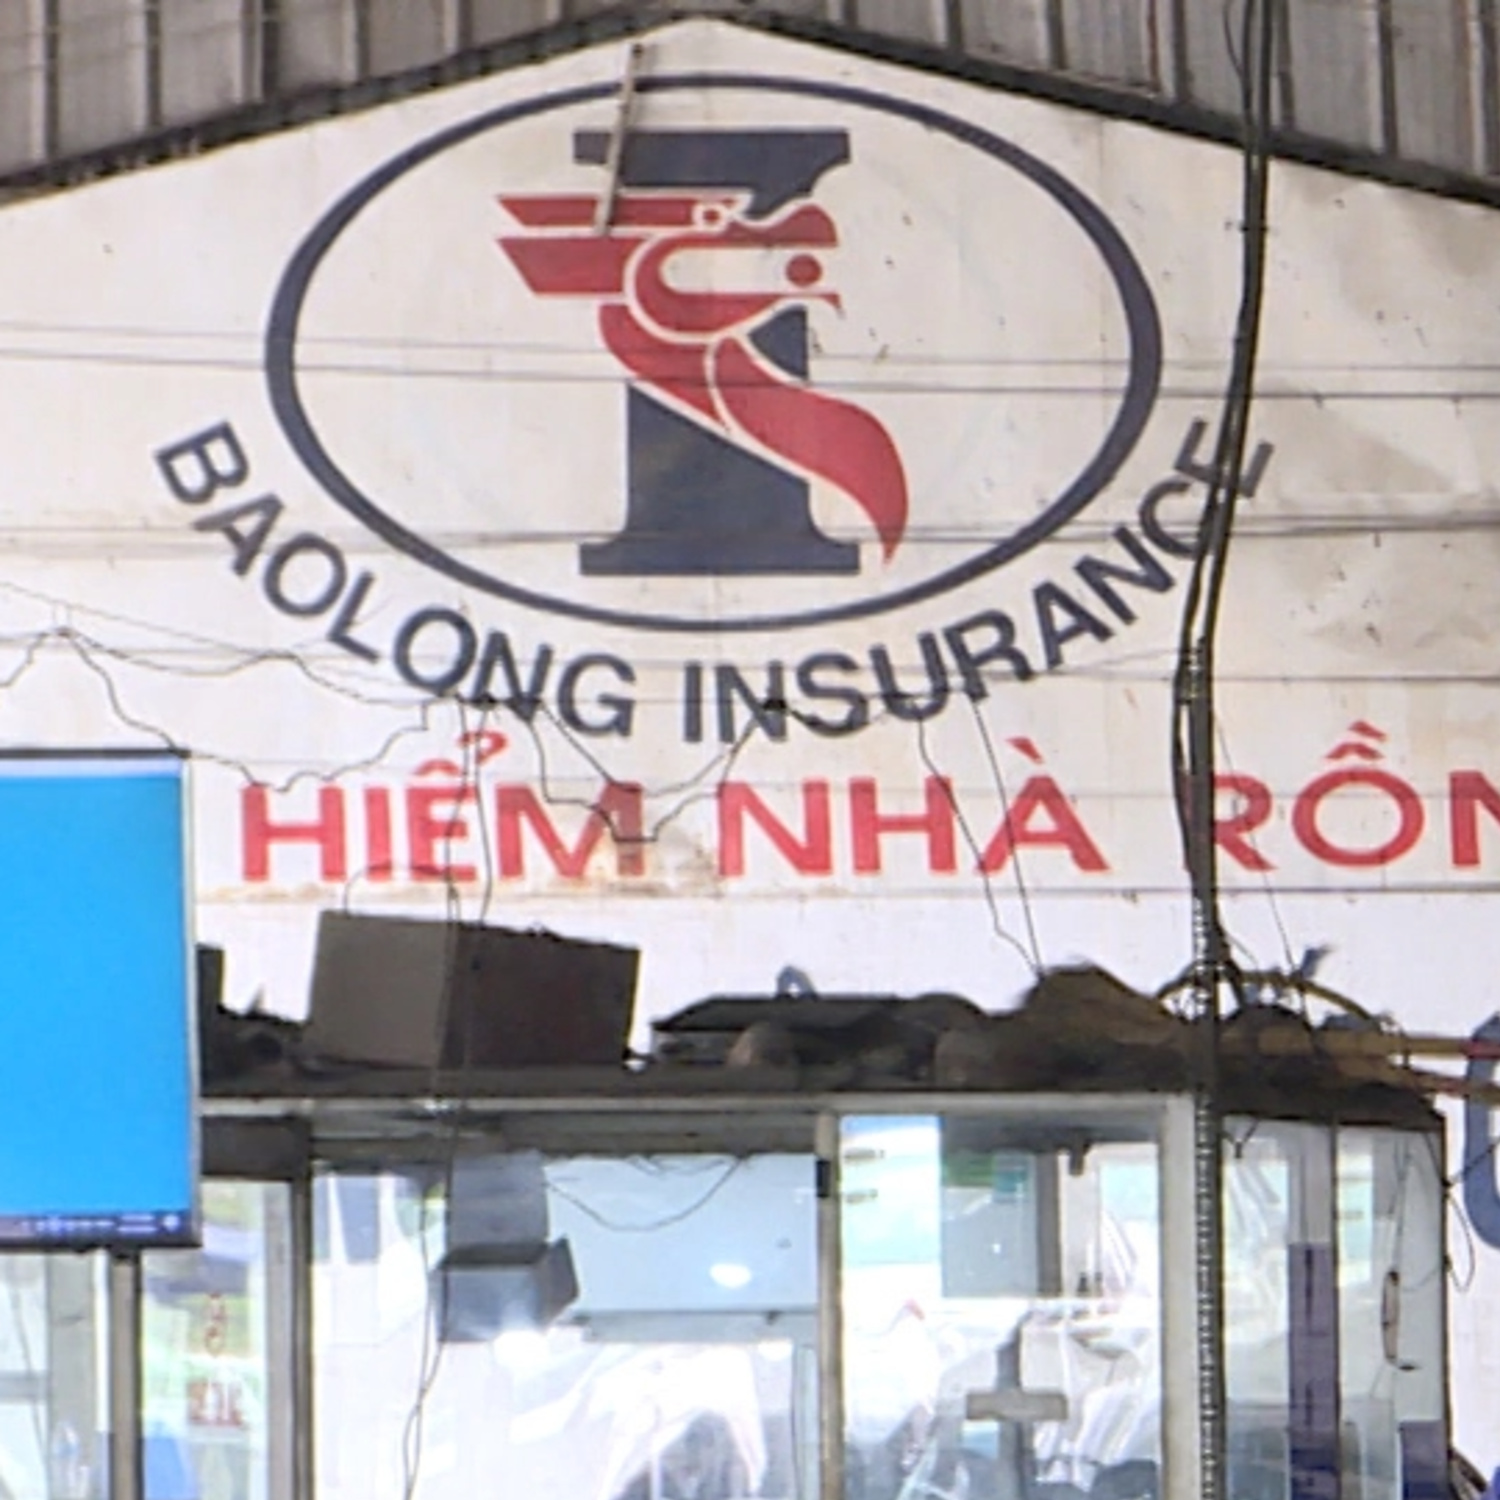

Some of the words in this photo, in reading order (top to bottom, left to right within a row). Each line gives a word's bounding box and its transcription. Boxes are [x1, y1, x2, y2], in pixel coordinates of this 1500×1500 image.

[155, 420, 638, 737] BAOLONG
[684, 417, 1274, 743] INSURANCE
[241, 731, 642, 882] HIỂM
[719, 738, 1110, 874] NHÀ
